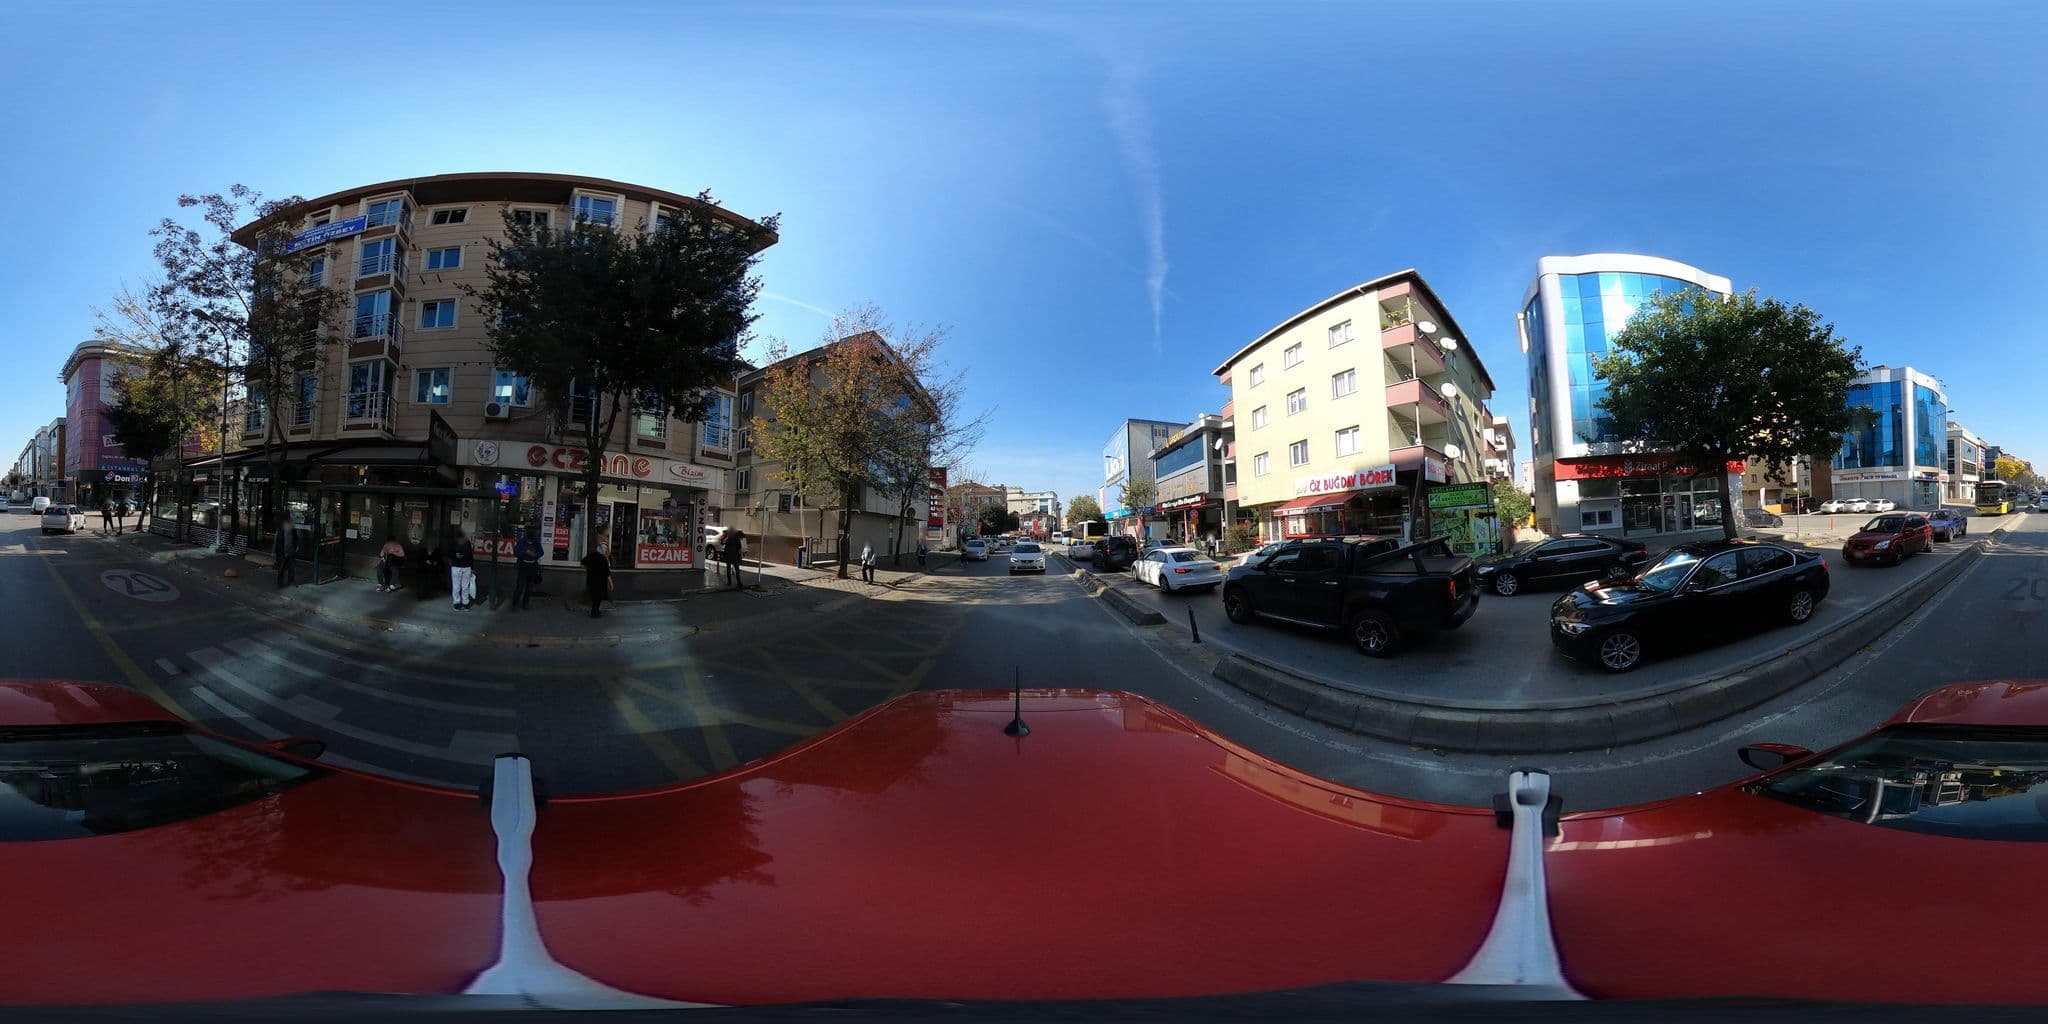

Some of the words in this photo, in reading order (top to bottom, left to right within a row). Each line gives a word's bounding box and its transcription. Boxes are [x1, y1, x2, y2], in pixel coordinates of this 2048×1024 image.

[1635, 461, 1660, 471] Ziraat
[1309, 479, 1321, 492] ÖZ
[1323, 474, 1357, 491] BUĞDAY
[1360, 468, 1393, 486] BÖREK
[696, 498, 706, 552] eczane
[641, 549, 689, 562] ECZANE
[105, 573, 171, 596] 20
